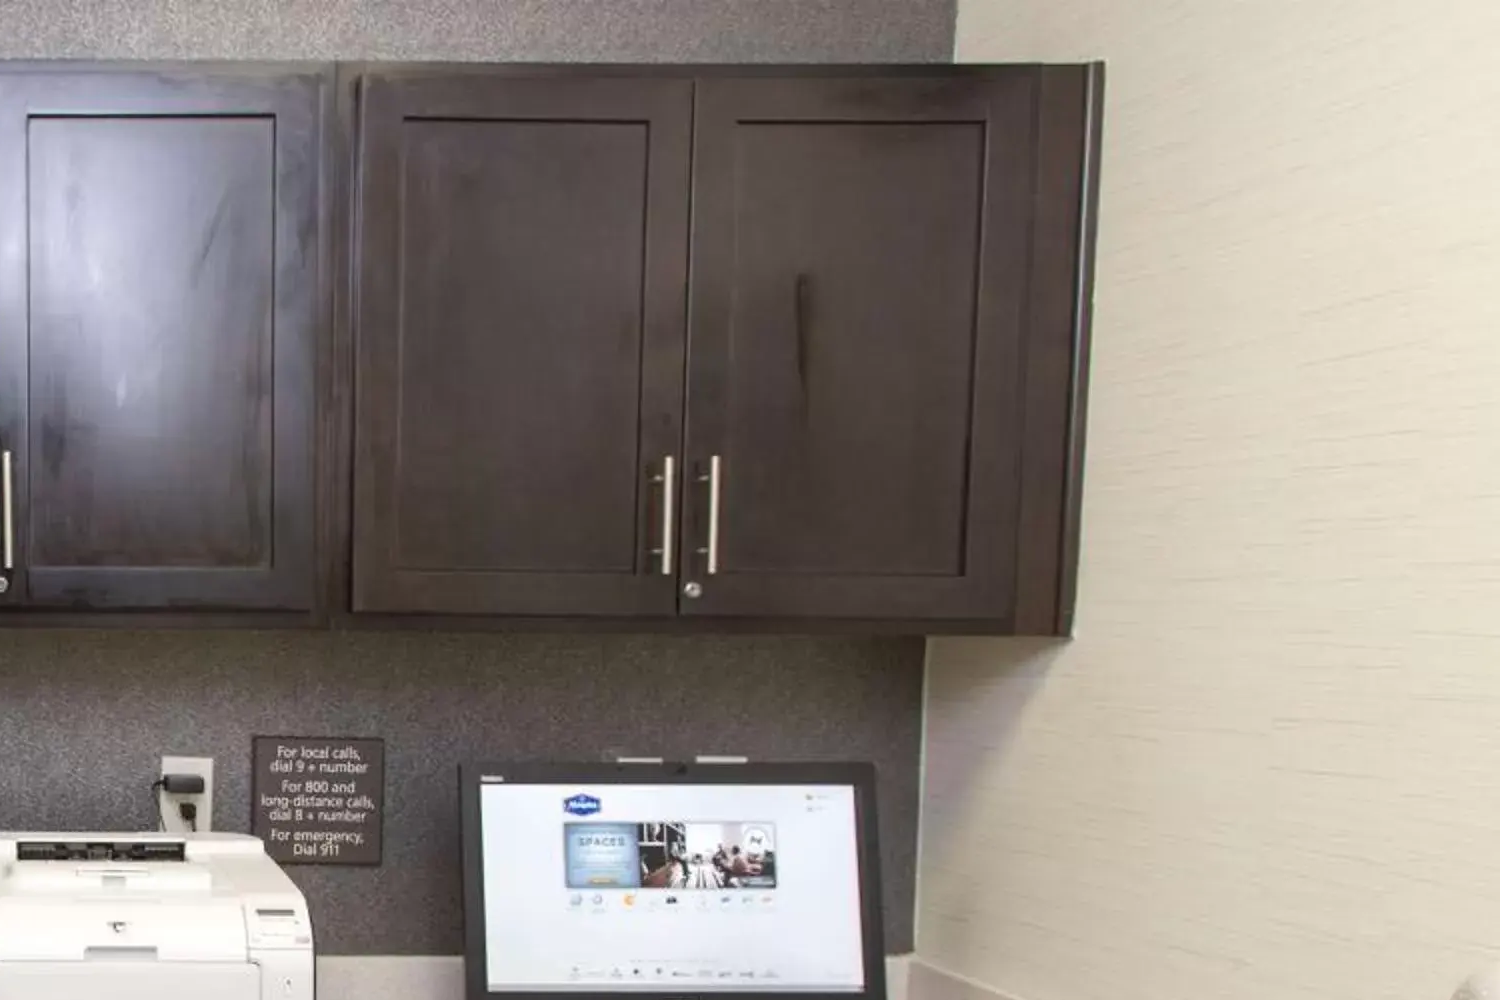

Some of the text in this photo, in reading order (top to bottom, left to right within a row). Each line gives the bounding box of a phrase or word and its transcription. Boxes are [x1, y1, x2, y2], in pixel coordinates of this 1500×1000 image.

[277, 745, 360, 760] For local calls,
[269, 760, 292, 772] dial
[295, 760, 304, 773] 9
[319, 761, 368, 773] number
[281, 780, 355, 793] For 800 and
[261, 794, 375, 810] long-distance calls,
[269, 809, 292, 821] dial
[295, 809, 303, 821] 8
[317, 810, 366, 822] number
[271, 828, 291, 841] For
[293, 843, 340, 856] Dial 911
